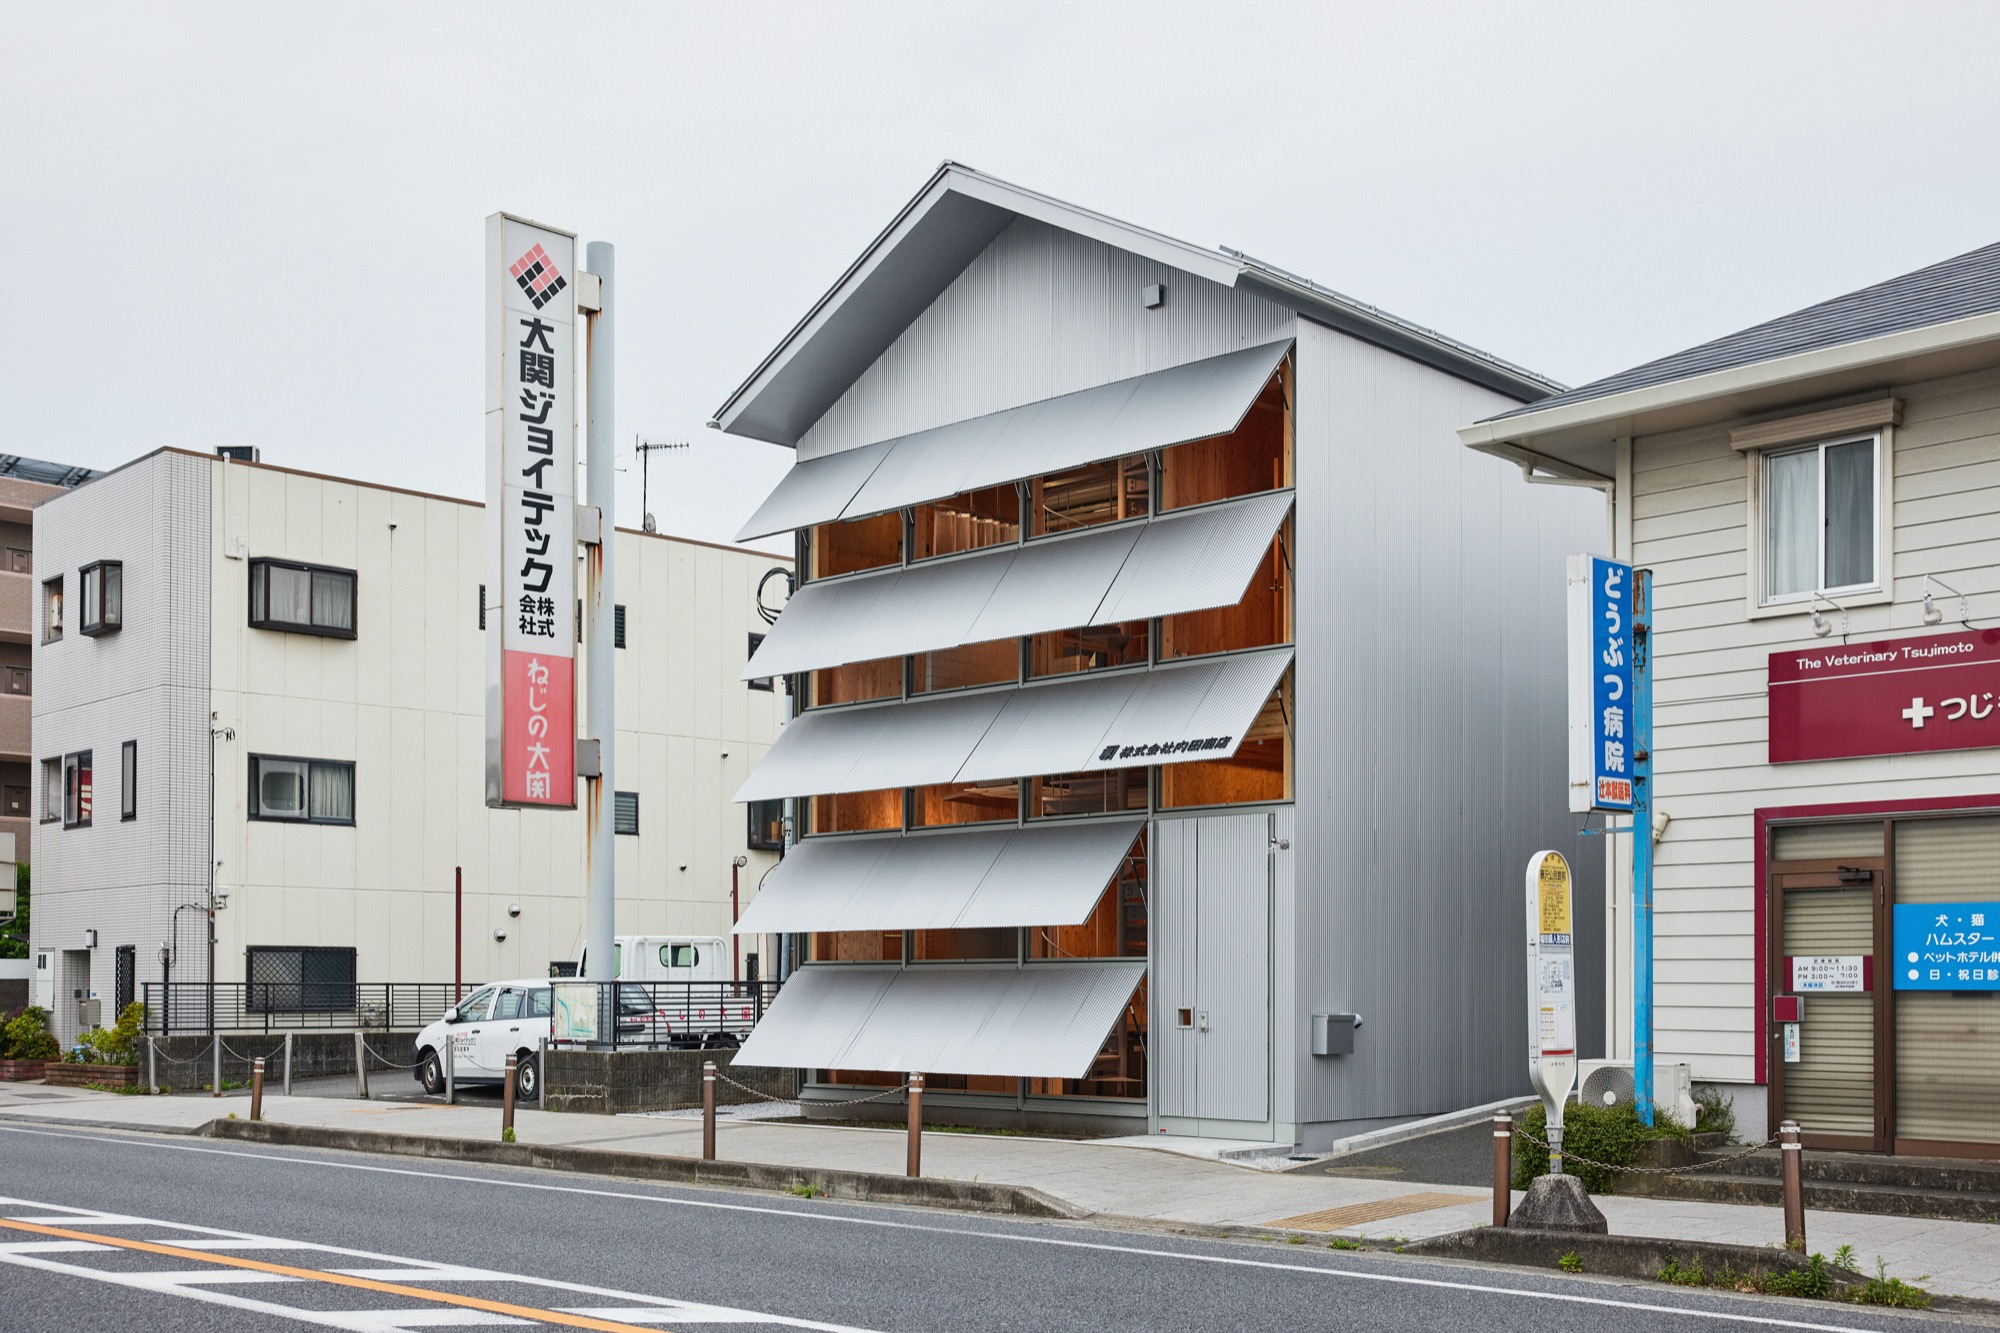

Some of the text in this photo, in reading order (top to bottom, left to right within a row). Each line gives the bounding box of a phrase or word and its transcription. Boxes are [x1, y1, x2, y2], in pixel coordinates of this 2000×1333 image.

[1603, 567, 1625, 773] どうぶつ病院
[1796, 641, 1974, 671] The Veterinary Tsujimoto
[1940, 692, 2000, 721] つじ
[525, 657, 551, 800] ねじの大関
[1118, 735, 1233, 759] 株式会社内田商店
[1925, 931, 1995, 947] ハムスター
